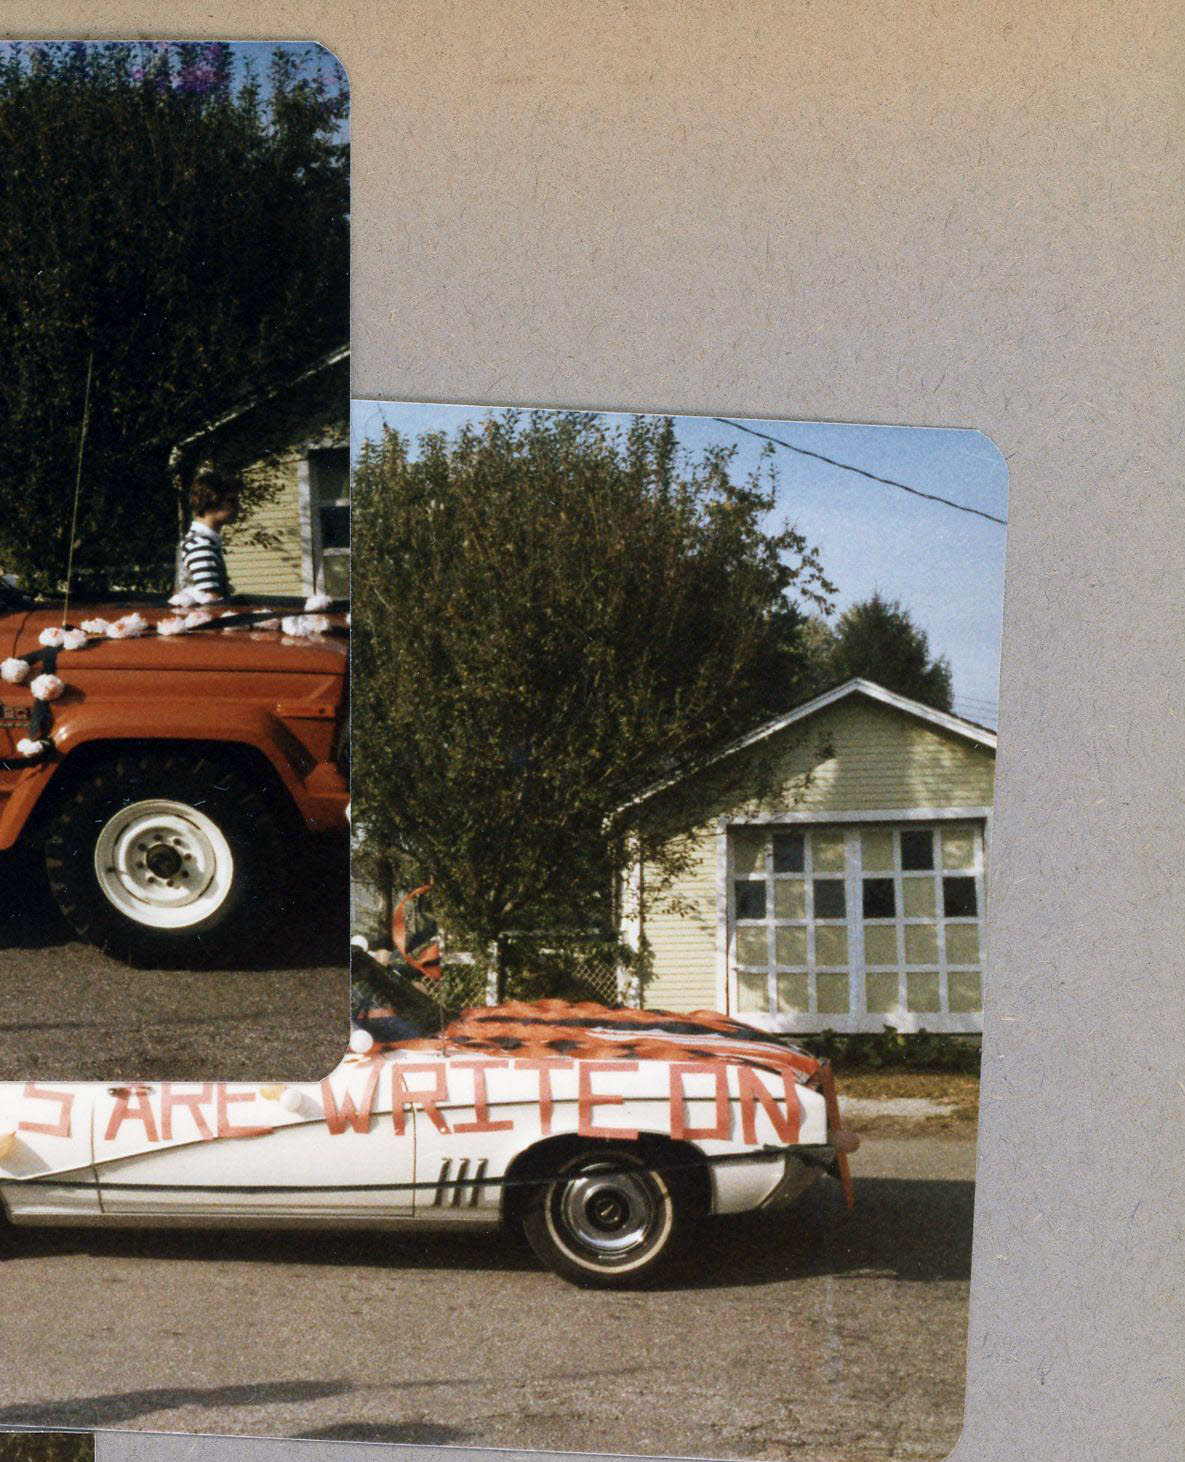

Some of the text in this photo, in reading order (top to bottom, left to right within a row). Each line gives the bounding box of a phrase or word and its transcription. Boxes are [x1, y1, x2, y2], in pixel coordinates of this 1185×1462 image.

[104, 1081, 274, 1143] ARE
[320, 1059, 640, 1141] WRITE
[669, 1062, 802, 1145] ON
